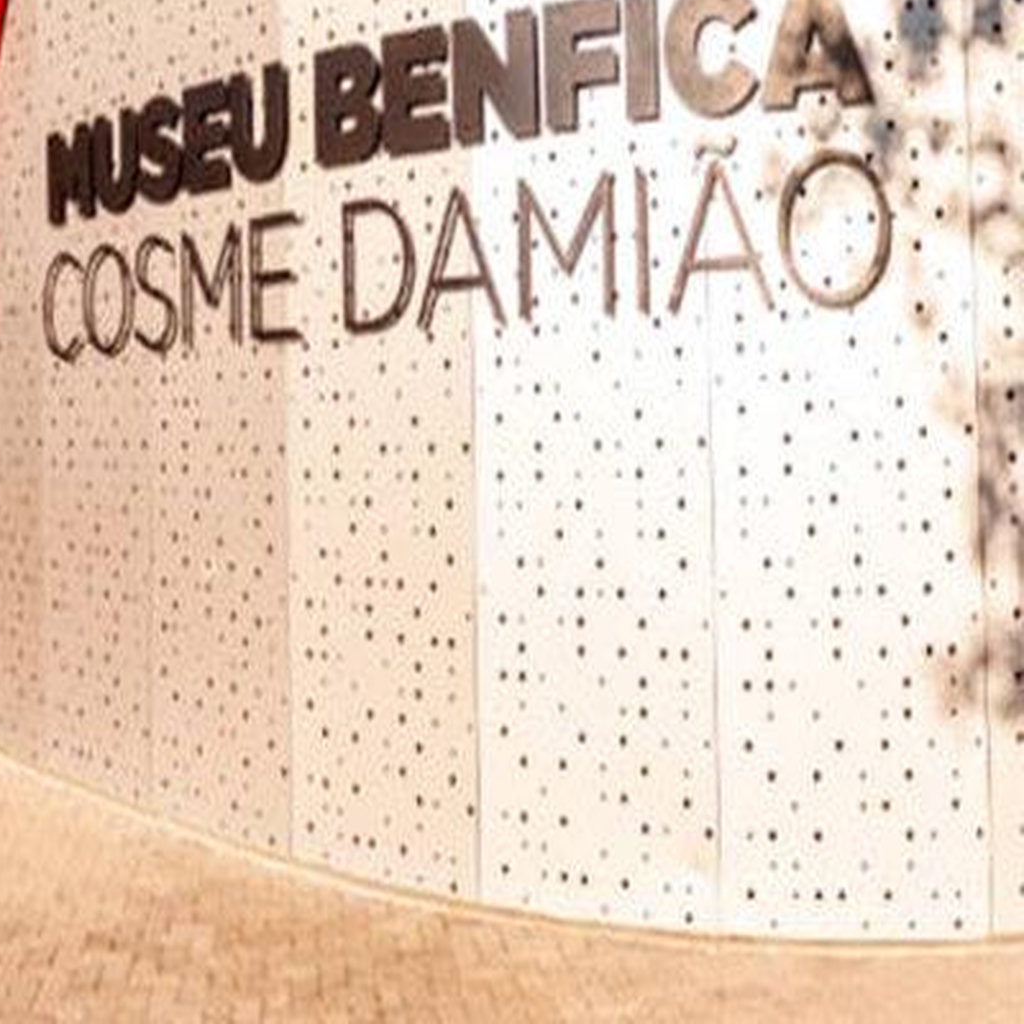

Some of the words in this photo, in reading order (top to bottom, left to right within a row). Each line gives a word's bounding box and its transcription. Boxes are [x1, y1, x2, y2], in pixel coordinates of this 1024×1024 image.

[45, 61, 290, 226] MUSEU
[43, 212, 305, 363] COSME
[341, 136, 893, 335] DAMIÃO
